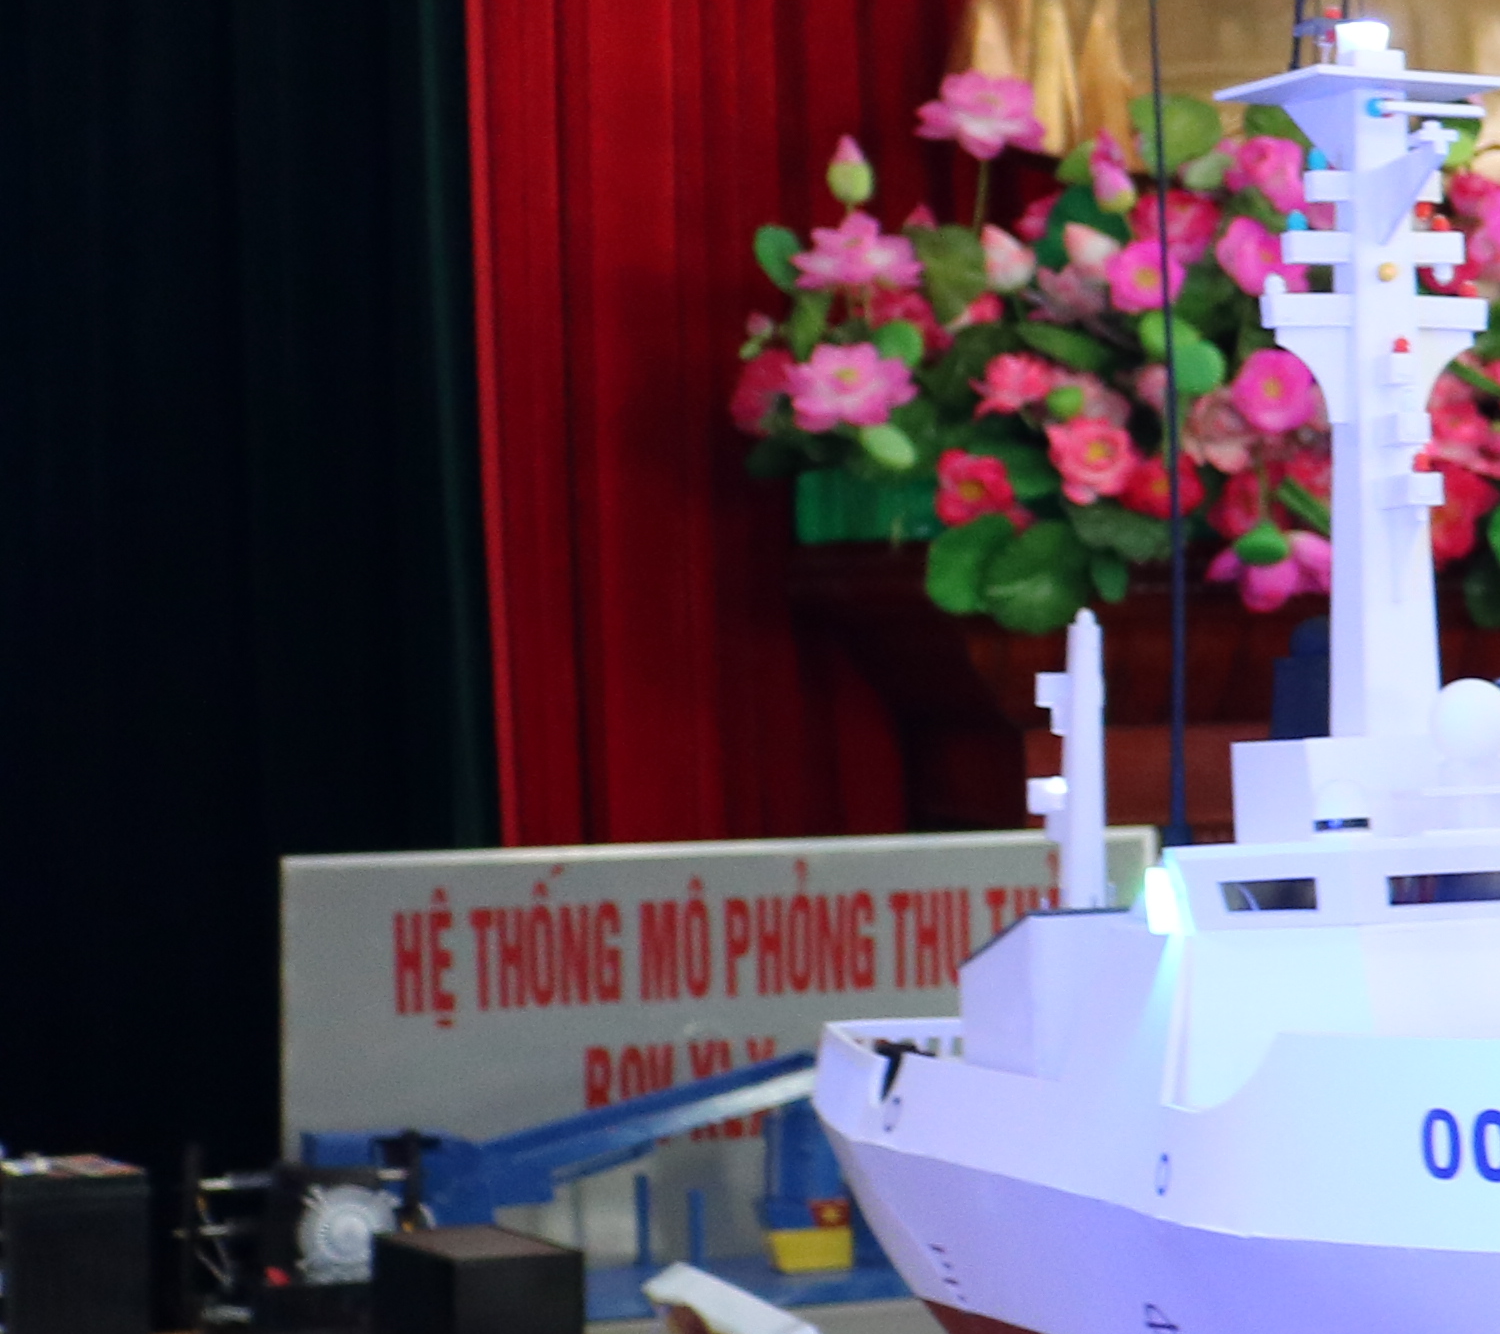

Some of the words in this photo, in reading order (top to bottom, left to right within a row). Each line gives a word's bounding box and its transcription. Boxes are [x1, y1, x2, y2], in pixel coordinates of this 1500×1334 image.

[394, 887, 456, 1030] HỆ
[468, 865, 624, 1009] THỐNG
[638, 877, 712, 1001] MÔ
[722, 859, 876, 998] PHỎNG
